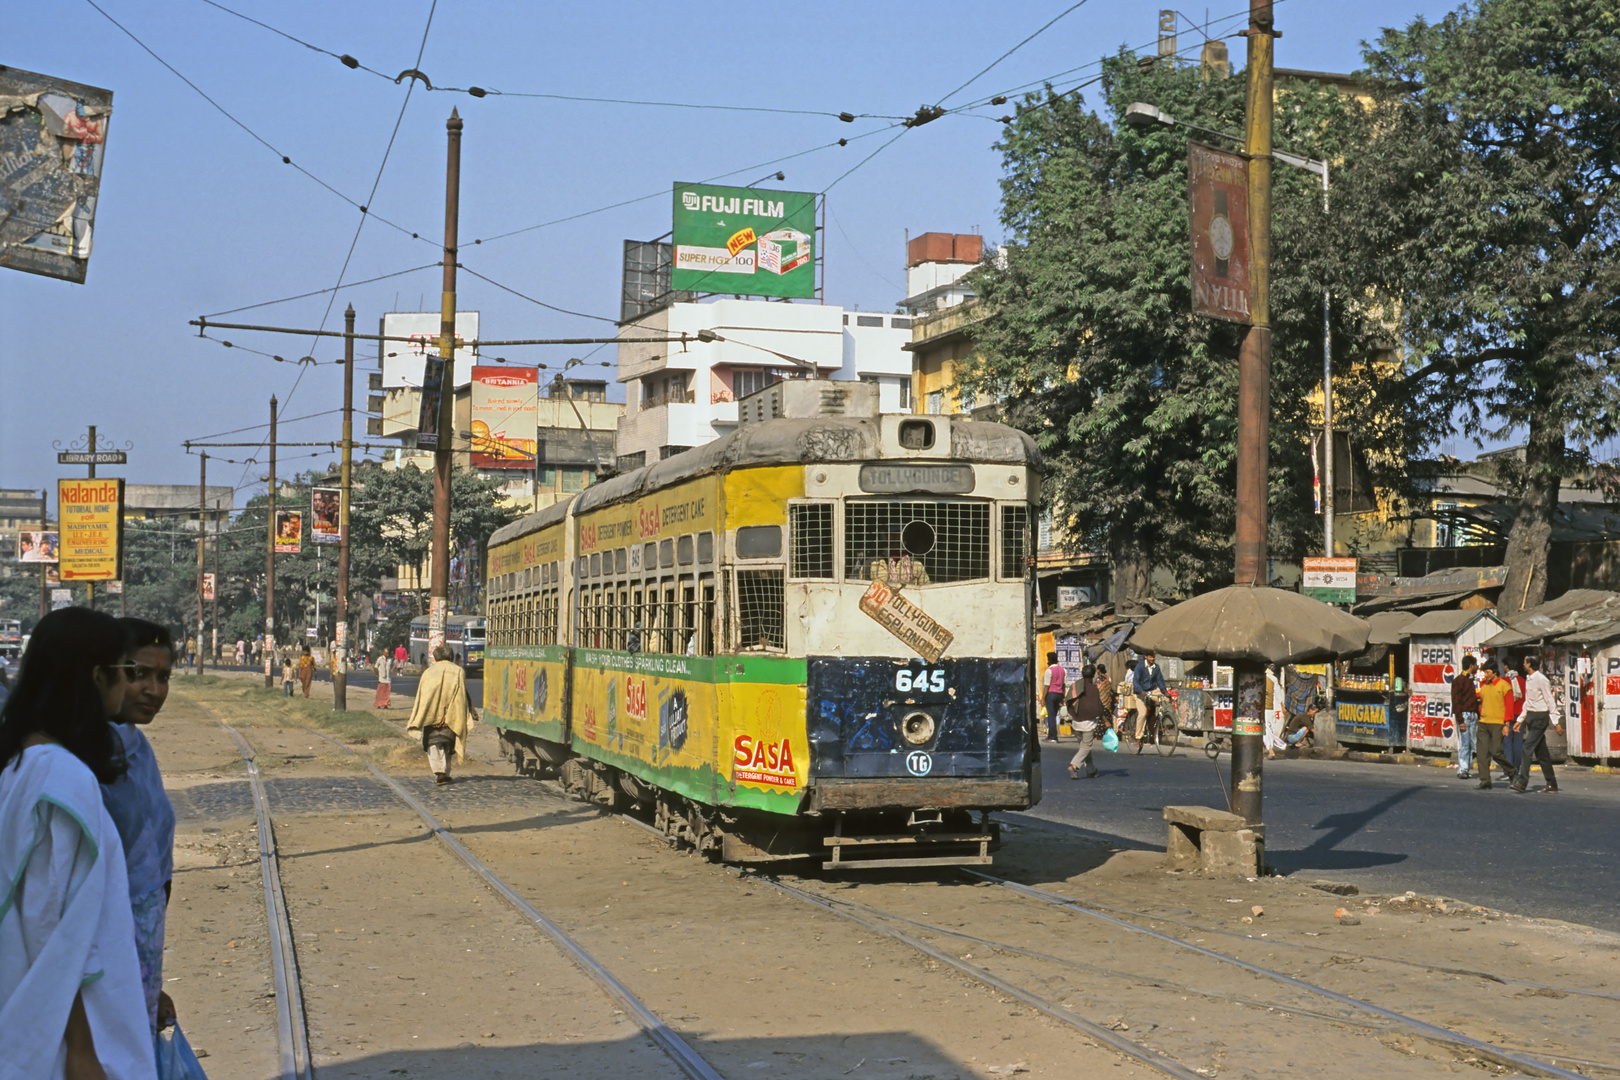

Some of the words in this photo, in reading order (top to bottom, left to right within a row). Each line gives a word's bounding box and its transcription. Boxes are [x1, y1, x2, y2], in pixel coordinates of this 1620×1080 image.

[702, 196, 740, 214] FUJI
[743, 199, 784, 218] FILM
[730, 231, 753, 252] NEW
[679, 253, 706, 263] SUPER
[735, 256, 753, 266] 100
[1196, 283, 1245, 314] TITAN
[485, 378, 526, 386] BRITANNIA
[60, 454, 95, 463] LIBRARY
[96, 454, 118, 462] ROAD
[870, 468, 959, 485] TOLLYGUNGE
[61, 482, 116, 503] Nalanda
[66, 505, 92, 514] TUTORIAL
[94, 504, 111, 513] HOME
[581, 521, 597, 551] SASA
[639, 503, 660, 539] SASA
[662, 503, 690, 527] DETERGENT
[691, 498, 705, 520] CAKE
[66, 538, 108, 546] ENGINEERING
[1358, 575, 1377, 584] NEW
[887, 595, 951, 647] TOLLYGUNGE
[877, 606, 940, 658] ESPLANADE
[585, 652, 598, 664] WASH
[612, 655, 633, 668] CLOTHES
[635, 656, 664, 672] SPARKLING
[1422, 648, 1453, 664] PEPSI
[895, 669, 945, 693] 645
[1568, 651, 1580, 718] PEPSI
[626, 674, 646, 721] SASA
[1338, 703, 1387, 724] HUNGAMA
[734, 734, 795, 774] SASA
[911, 755, 928, 772] TG
[736, 771, 762, 781] DETERGENT
[763, 774, 779, 783] POWDER
